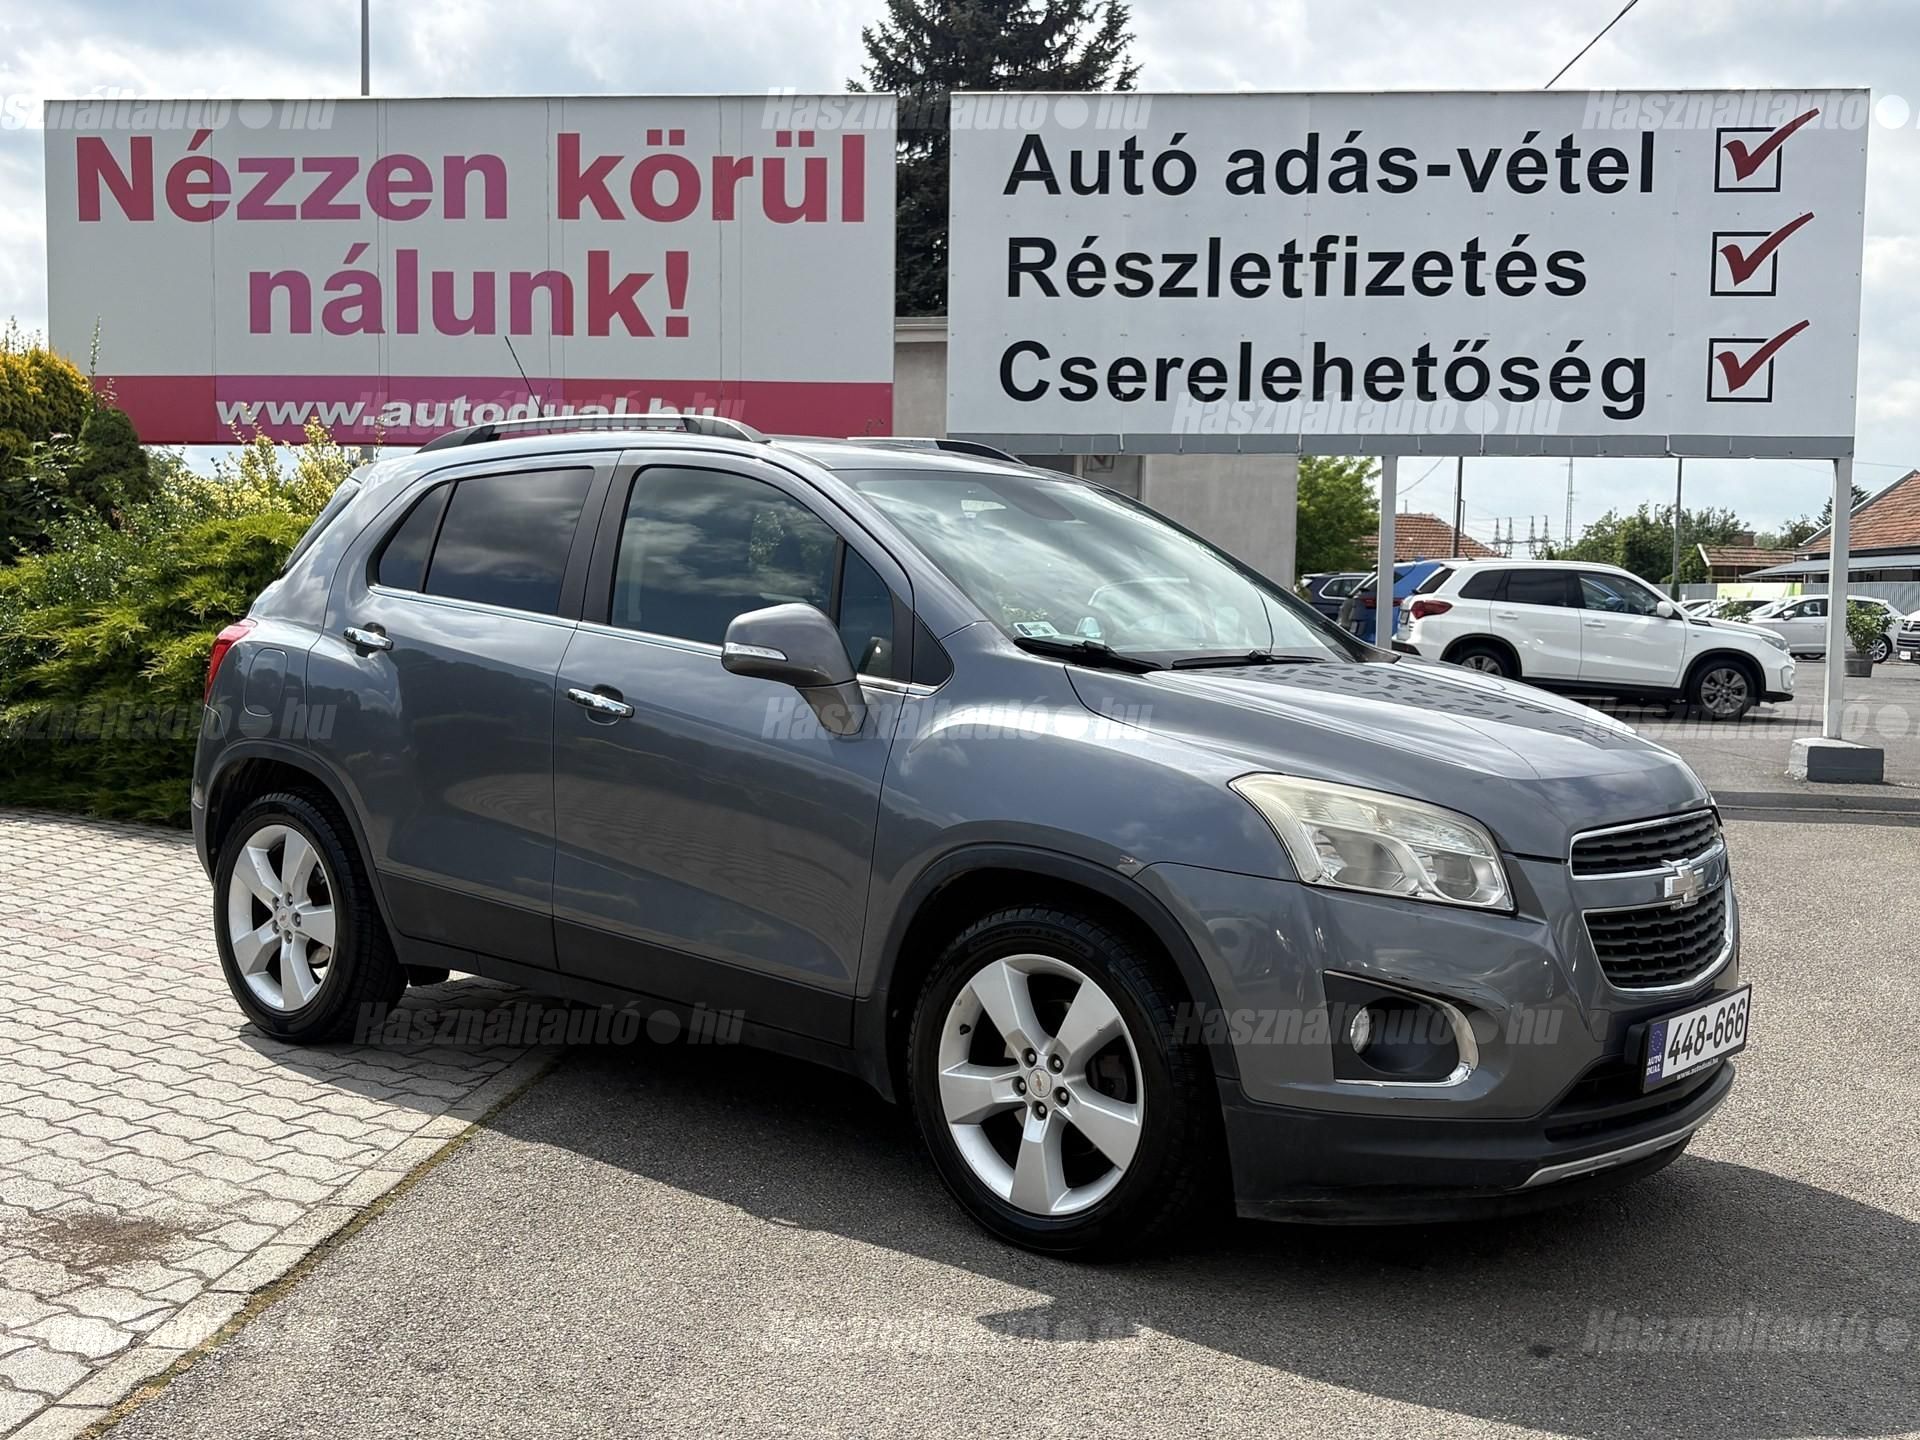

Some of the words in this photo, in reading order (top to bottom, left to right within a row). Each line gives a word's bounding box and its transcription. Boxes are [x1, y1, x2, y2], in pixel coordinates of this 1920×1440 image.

[76, 129, 507, 223] Nézzen
[556, 129, 866, 223] körül
[1003, 132, 1198, 195] Autó
[1224, 131, 1655, 195] adás-vétel
[248, 242, 690, 338] nálunk!
[1006, 232, 1587, 298] Részletfizetés
[1000, 336, 1648, 420] Cserelehetőség
[1668, 998, 1745, 1065] 448-666
